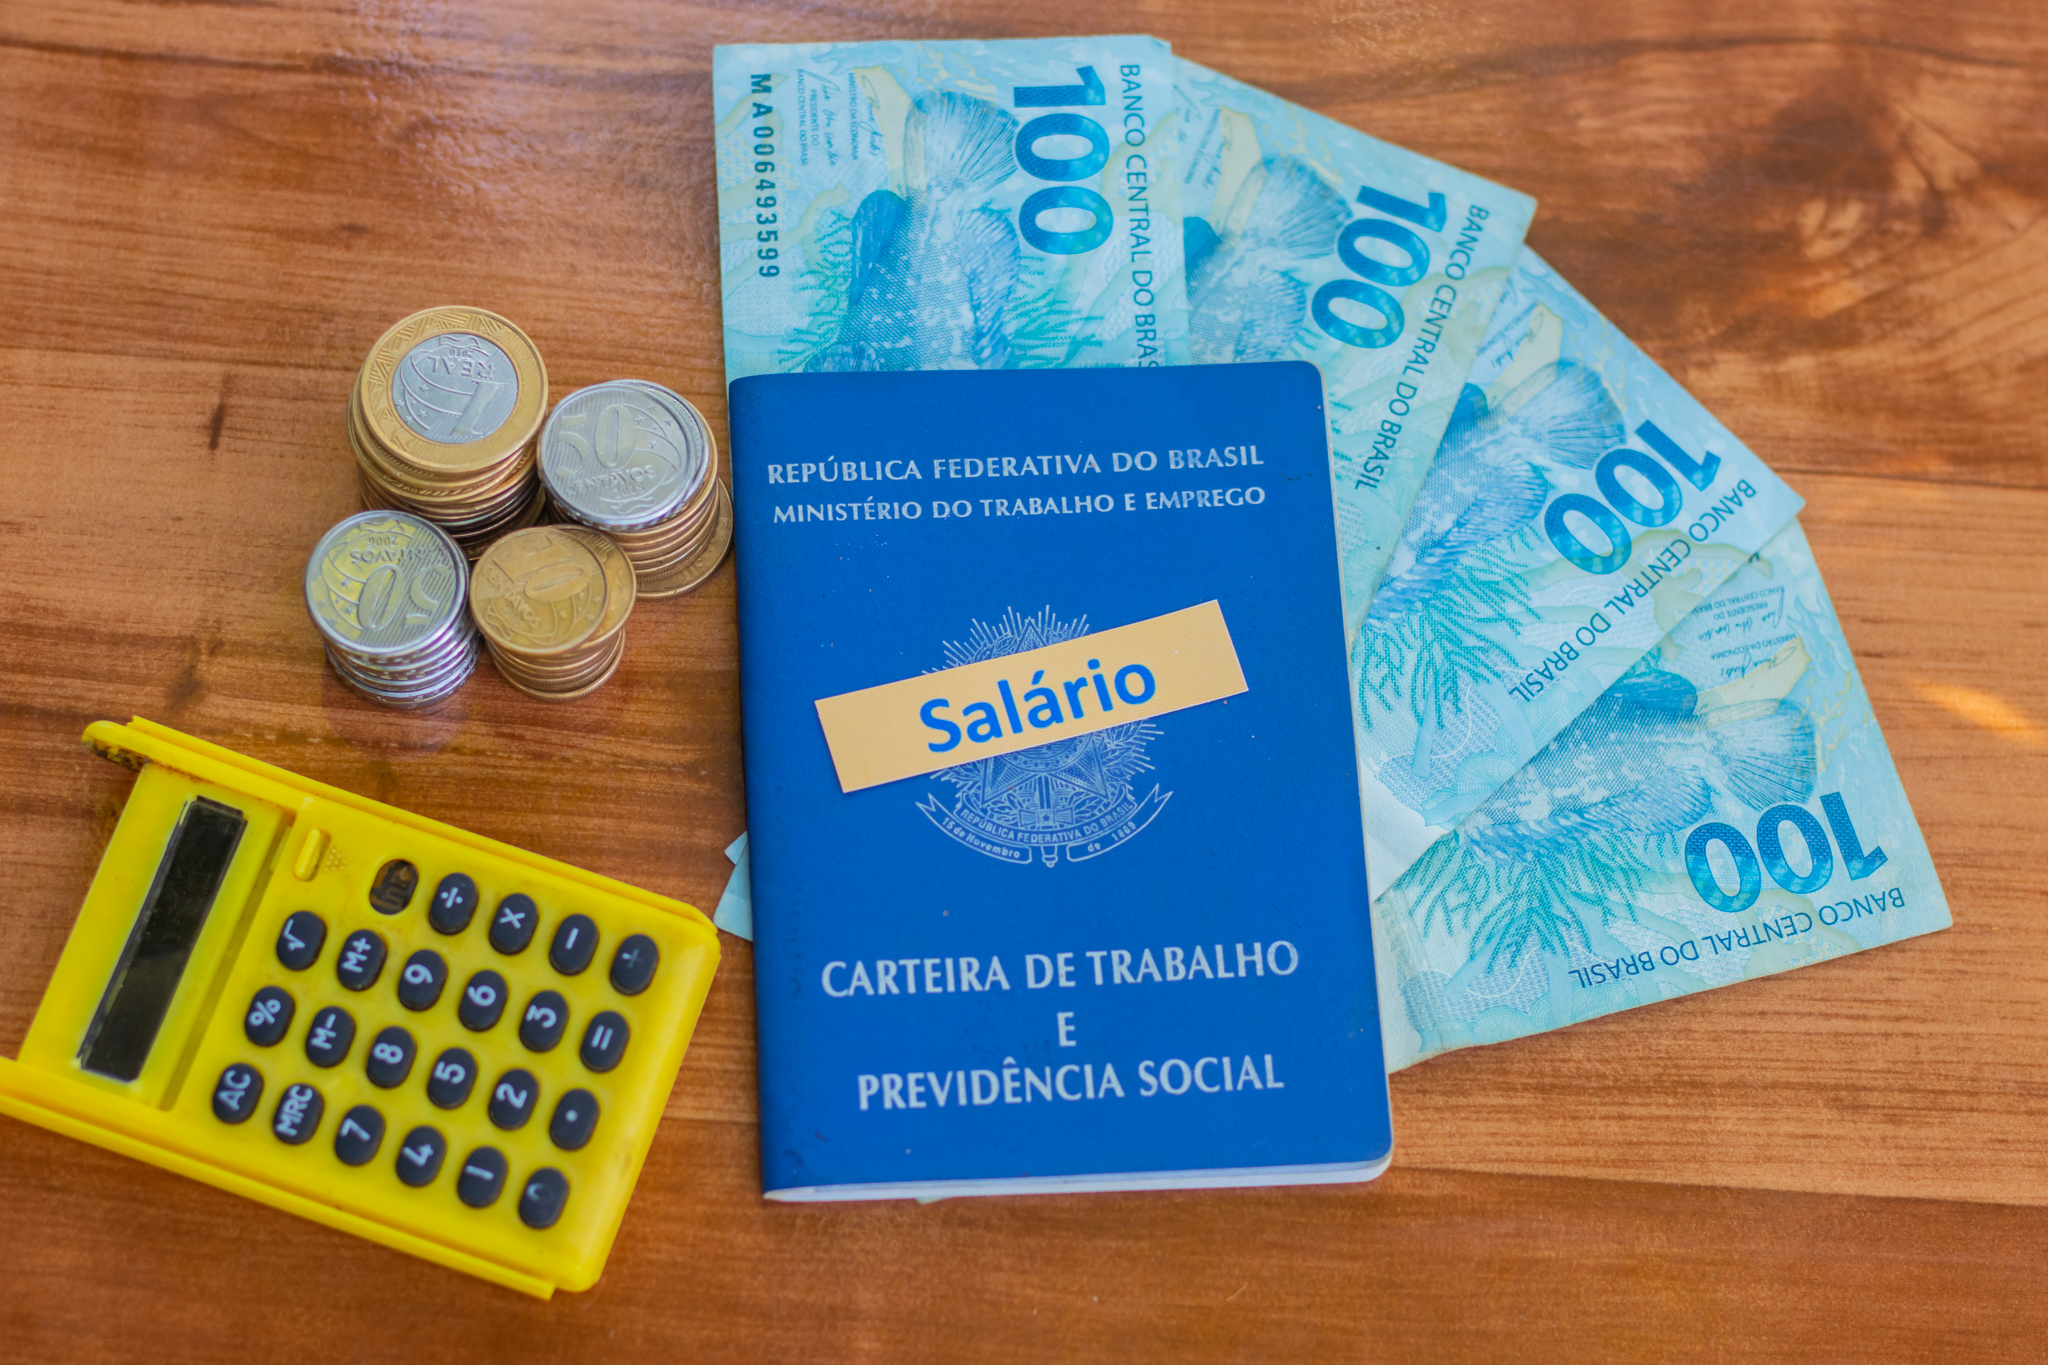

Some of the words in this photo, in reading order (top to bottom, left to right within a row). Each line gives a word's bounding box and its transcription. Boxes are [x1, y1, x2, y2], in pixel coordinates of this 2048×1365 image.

[810, 89, 819, 132] PRESIDENTE
[1119, 63, 1146, 148] BANCO
[1013, 66, 1114, 256] 100
[1126, 154, 1152, 261] CENTRAL
[1445, 204, 1490, 281] BANCO
[1311, 185, 1447, 349] 100
[1132, 270, 1155, 308] DO
[1135, 314, 1160, 368] BRAS
[1402, 284, 1457, 378] CENTRAL
[427, 355, 496, 381] REAL
[1388, 382, 1418, 417] DO
[767, 455, 922, 485] REPÚBLICA
[933, 452, 1102, 480] FEDERATIVA
[1112, 450, 1158, 473] DO
[1168, 445, 1265, 471] BRASIL
[1354, 419, 1403, 491] BRASIL
[773, 496, 922, 524] MINISTÉRIO
[932, 499, 973, 520] DO
[979, 494, 1115, 518] TRABALHO
[1124, 493, 1137, 512] E
[1146, 486, 1266, 511] EMPREGO
[1543, 419, 1722, 575] 100
[1688, 478, 1757, 542] BANCO
[1603, 538, 1692, 617] CENTRAL
[1574, 611, 1612, 646] DO
[1727, 601, 1768, 618] PRESIDENTE
[1508, 640, 1580, 704] BRASIL
[919, 657, 1157, 754] Salário
[942, 816, 954, 830] 15
[953, 825, 966, 837] de
[965, 832, 1021, 859] Novembro
[1087, 842, 1101, 853] de
[960, 808, 1016, 842] REPÚBLICA
[1017, 829, 1083, 844] FEDERATIVA
[1083, 822, 1099, 835] DO
[1100, 802, 1134, 828] BRASIL
[1684, 791, 1889, 914] 100
[1818, 885, 1906, 927] BANCO
[1659, 939, 1699, 966] DO
[1702, 910, 1813, 956] CENTRAL
[404, 963, 434, 985] 9
[821, 955, 1011, 998] CARTEIRA
[1025, 952, 1077, 989] DE
[1085, 940, 1300, 986] TRABALHO
[1568, 949, 1655, 989] BRASIL
[467, 984, 497, 1007] 6
[526, 1005, 558, 1029] 3
[1056, 1011, 1077, 1048] E
[373, 1042, 404, 1065] 8
[434, 1061, 466, 1085] 5
[220, 1069, 252, 1110] AC
[495, 1082, 528, 1109] 2
[857, 1056, 1125, 1111] PREVIDÊNCIA
[1138, 1054, 1285, 1097] SOCIAL
[276, 1085, 314, 1136] MRC
[340, 1118, 371, 1141] 7
[403, 1143, 434, 1166] 4
[465, 1165, 495, 1181] 1
